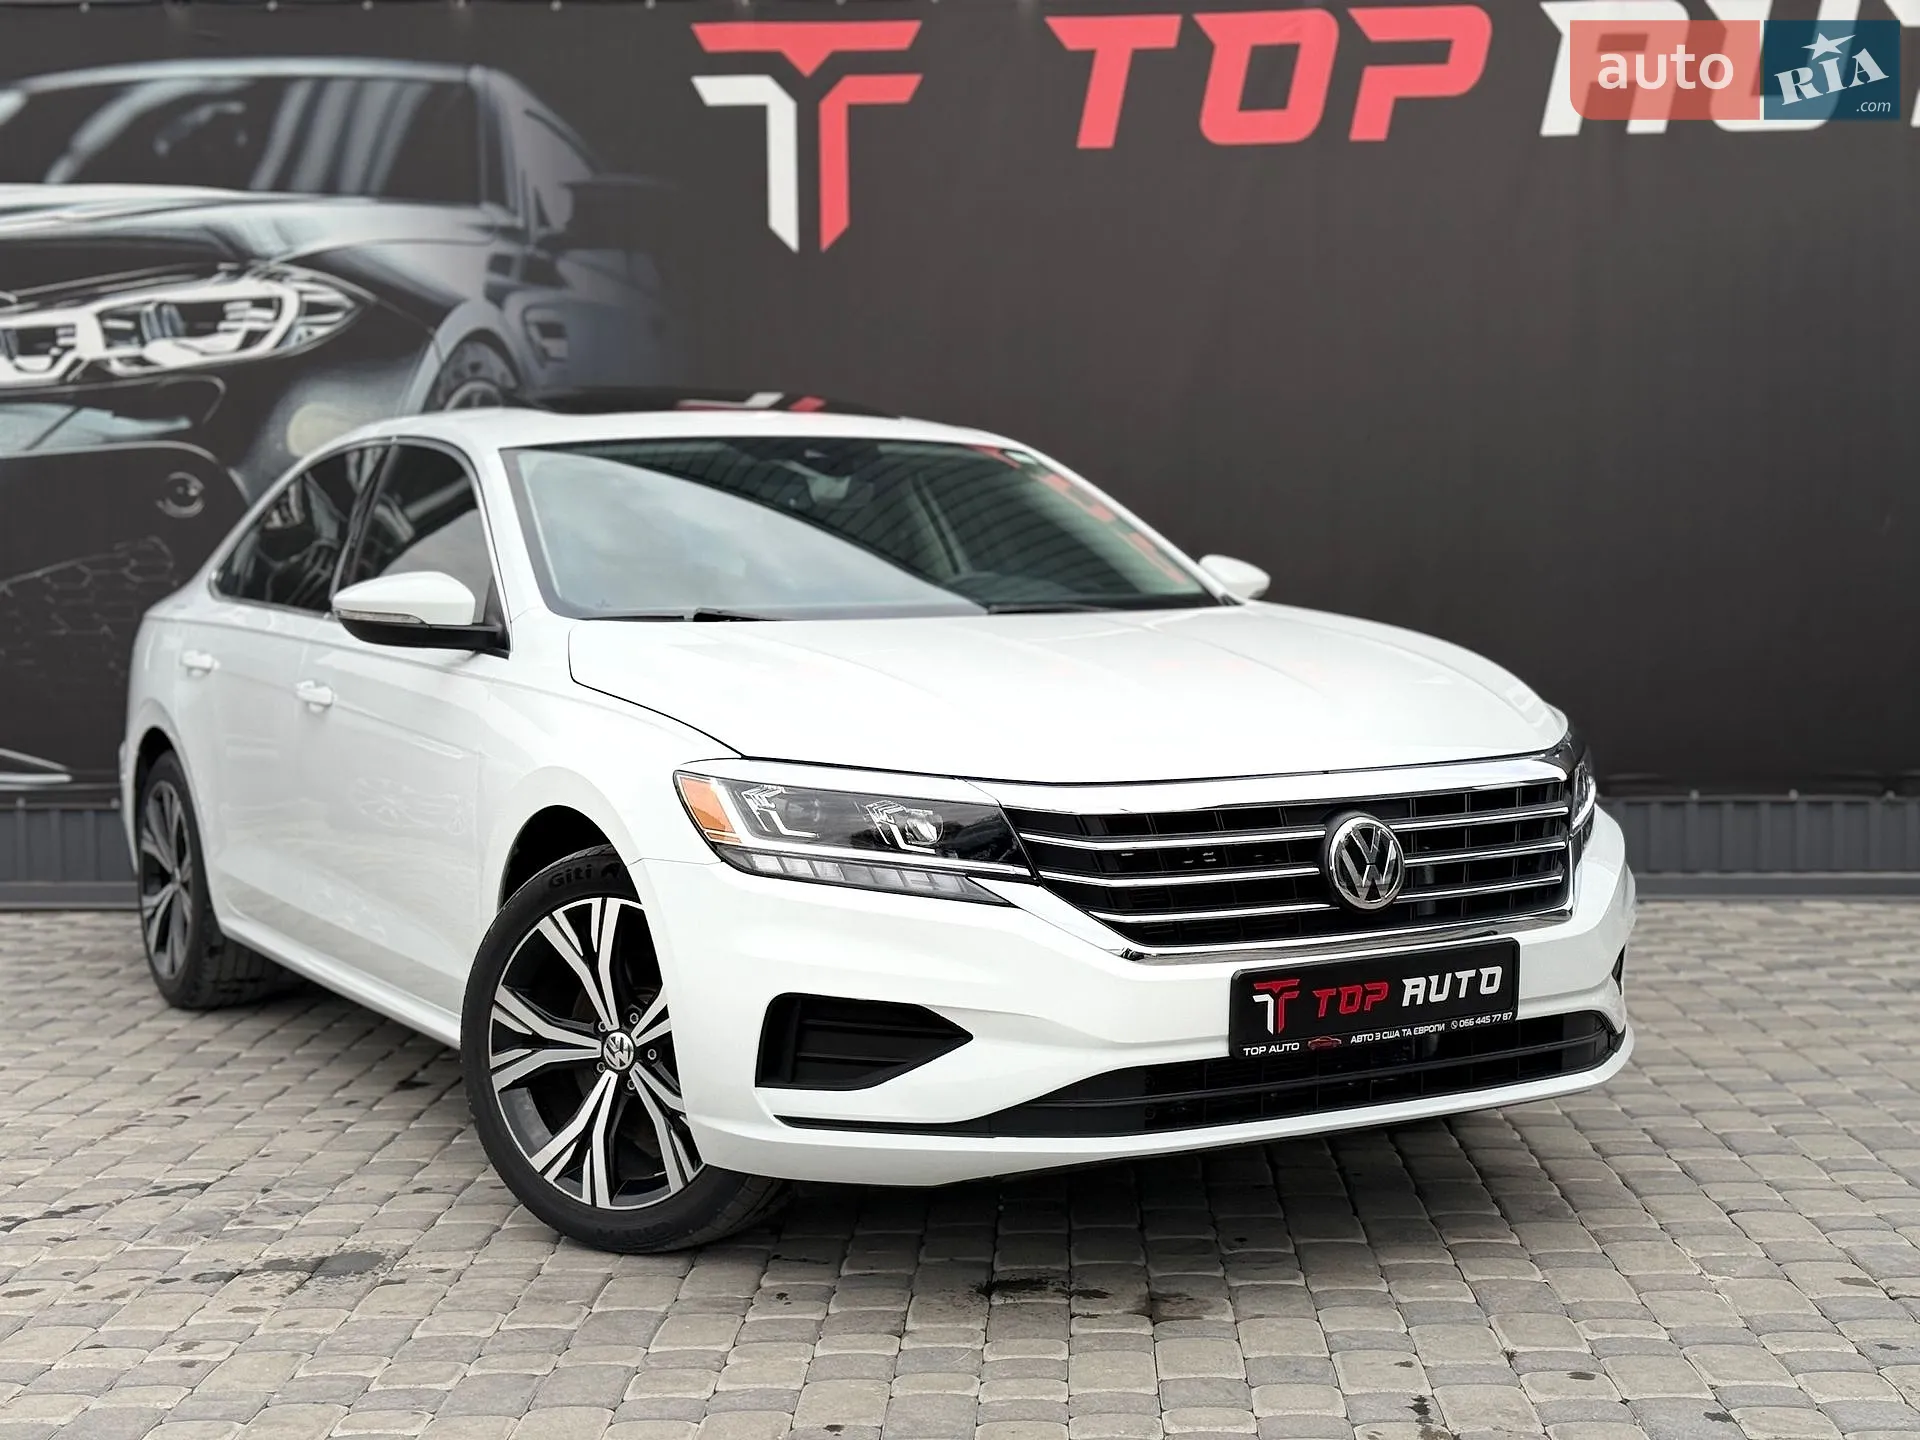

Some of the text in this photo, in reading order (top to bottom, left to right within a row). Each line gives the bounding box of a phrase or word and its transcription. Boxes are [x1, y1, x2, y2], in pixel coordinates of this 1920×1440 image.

[1044, 0, 1920, 149] TOP AU
[549, 864, 593, 888] Giti
[1312, 981, 1389, 1018] TOP
[1401, 966, 1502, 1007] AUTO
[1350, 1033, 1374, 1044] АВТО
[1382, 1030, 1400, 1039] США
[1475, 1015, 1491, 1024] 445
[1492, 1013, 1502, 1022] 77
[1502, 1011, 1513, 1020] 87
[1243, 1042, 1300, 1056] TOP AUTO
